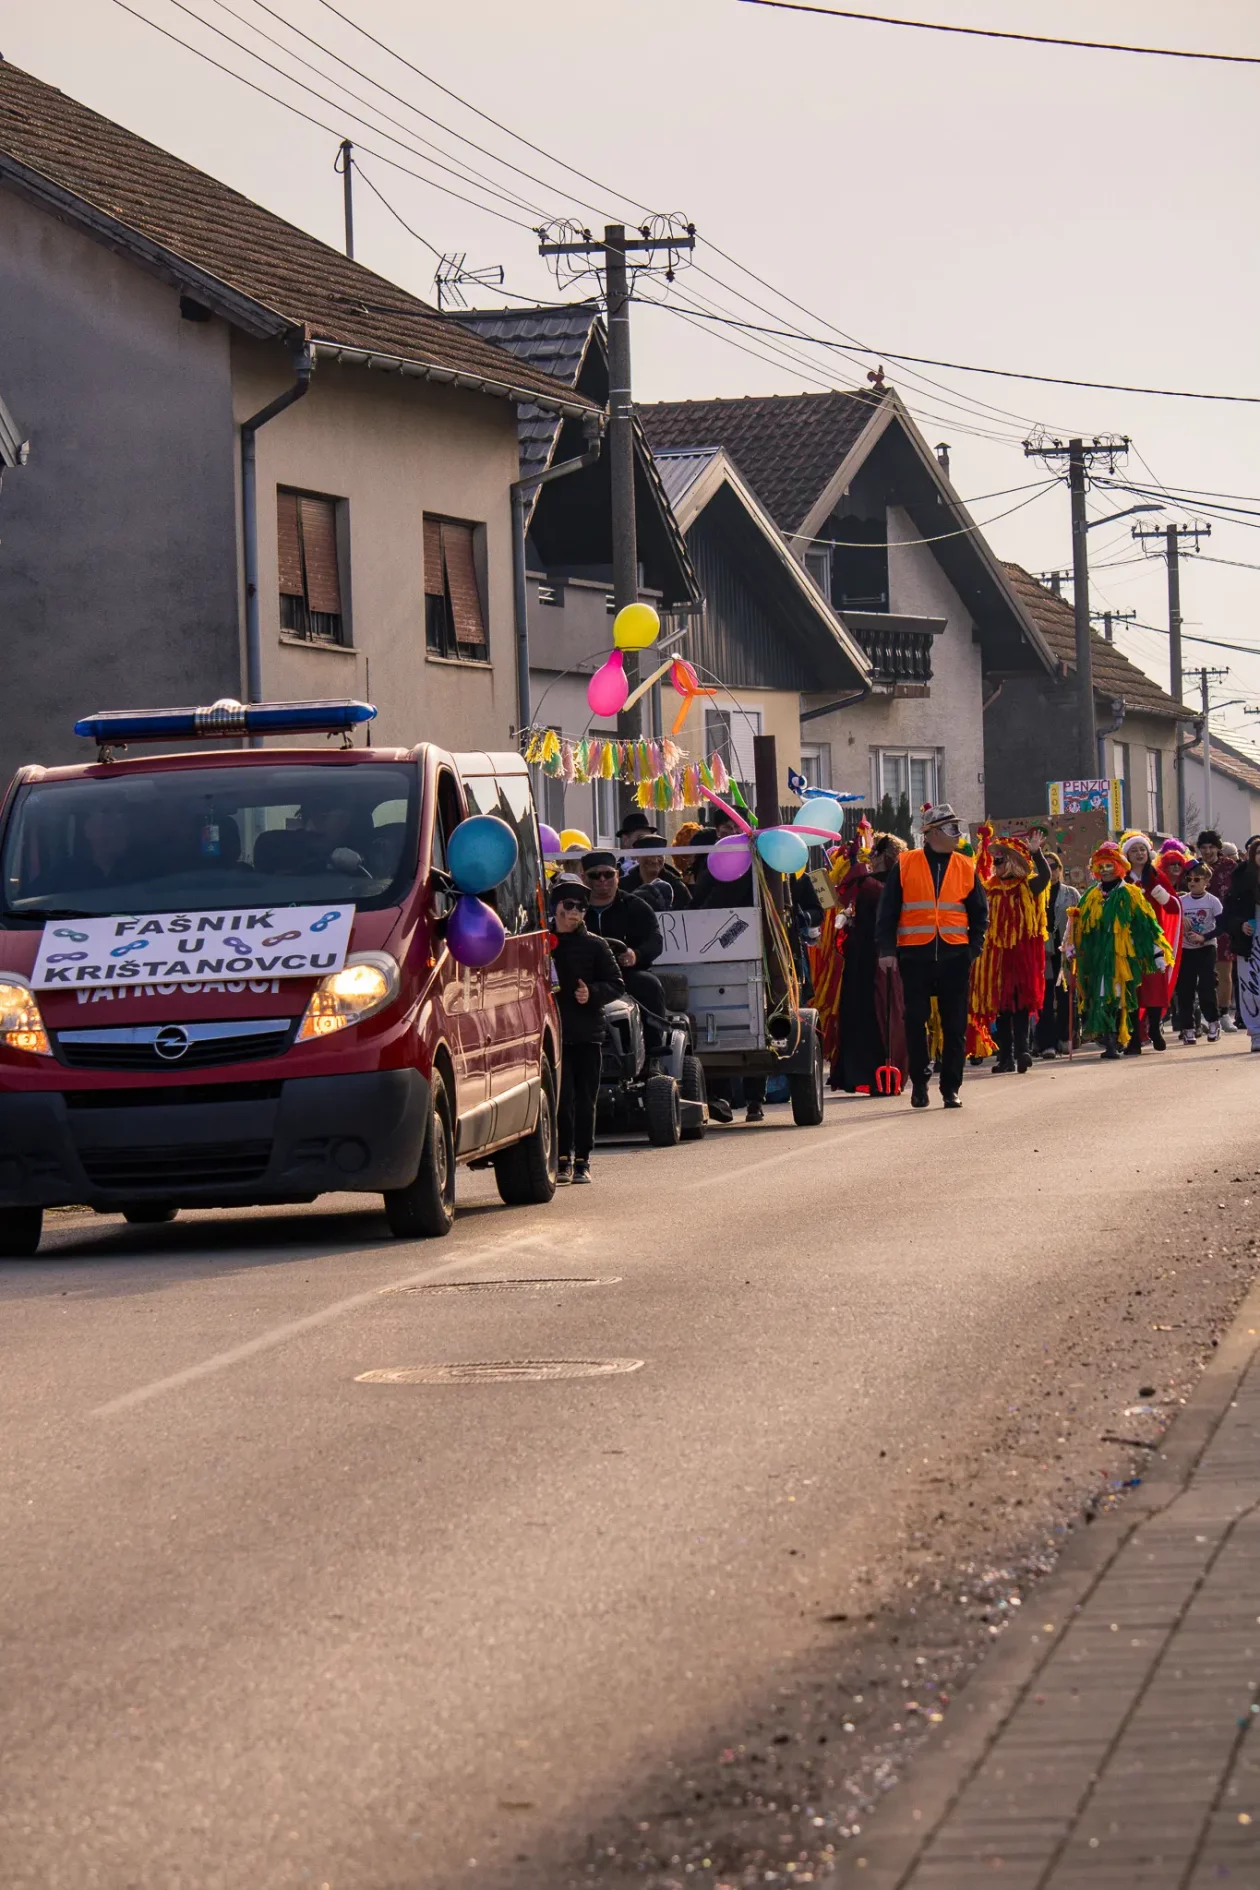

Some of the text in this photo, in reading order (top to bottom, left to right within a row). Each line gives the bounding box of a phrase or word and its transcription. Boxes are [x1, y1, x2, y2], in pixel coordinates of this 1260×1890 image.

[115, 914, 276, 937] FAŠNIK
[178, 938, 204, 953] U
[44, 953, 338, 982] KRIŠTANOVCU
